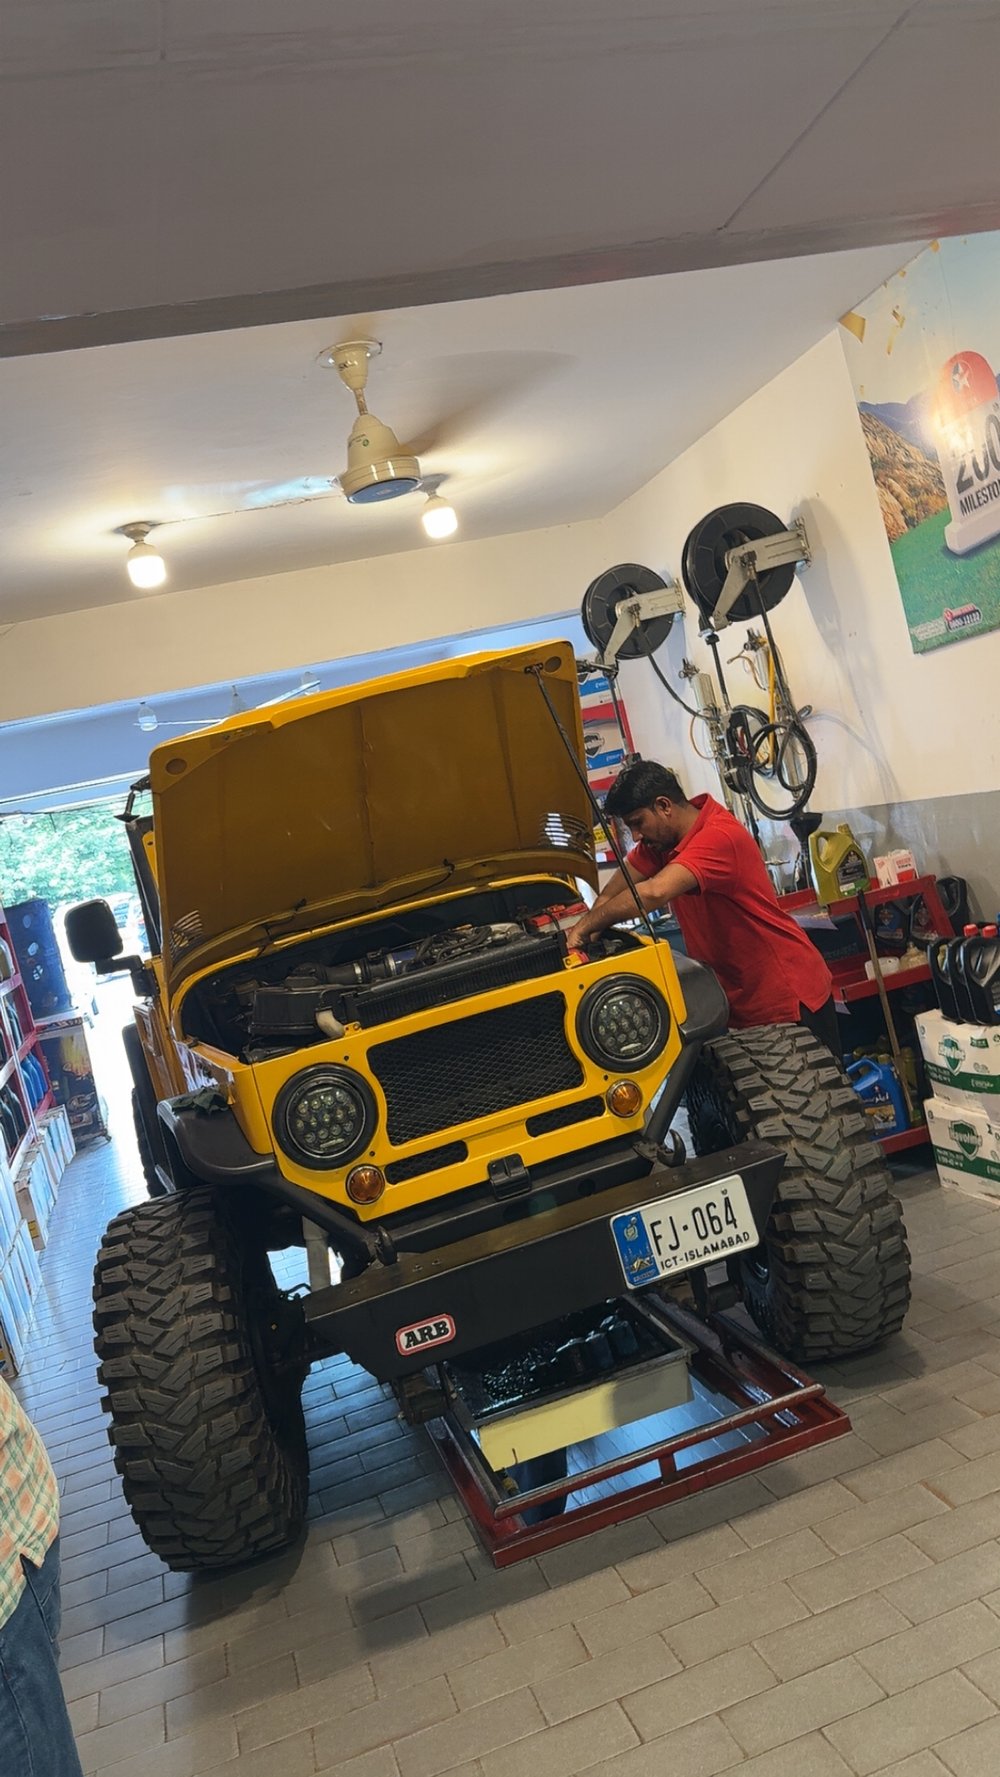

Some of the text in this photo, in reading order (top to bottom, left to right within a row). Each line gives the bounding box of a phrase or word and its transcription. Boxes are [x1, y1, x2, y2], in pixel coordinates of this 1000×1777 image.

[650, 1196, 738, 1256] FJ-064
[661, 1231, 749, 1270] ICT-ISLAMABAD
[404, 1320, 450, 1349] ARB
